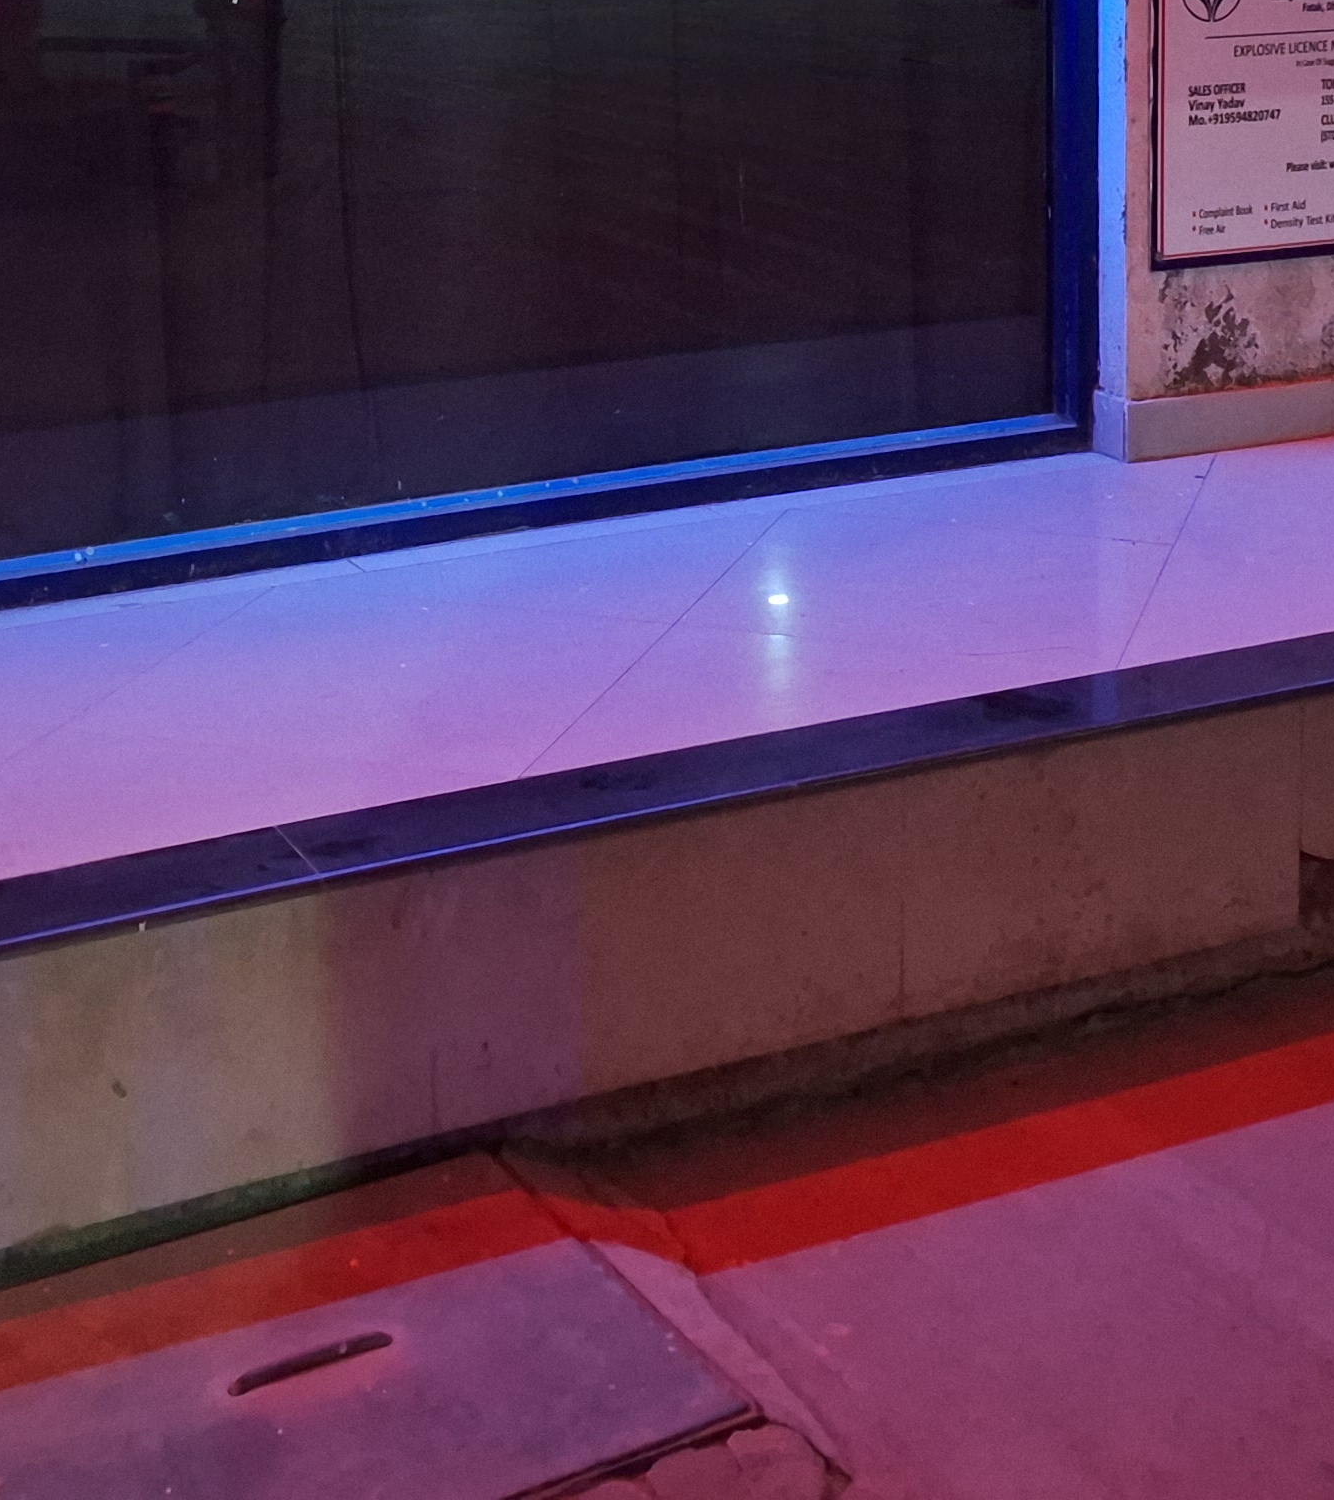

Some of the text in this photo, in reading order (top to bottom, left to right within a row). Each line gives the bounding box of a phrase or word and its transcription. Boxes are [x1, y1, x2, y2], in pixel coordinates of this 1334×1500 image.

[1233, 42, 1286, 58] EXPLOSIVE
[1288, 39, 1328, 55] LICENCE
[1188, 82, 1246, 97] SALES OFFICER
[1188, 95, 1246, 113] Vinay Yadav
[1270, 199, 1306, 213] First Aid
[1270, 217, 1304, 230] Density
[1305, 215, 1323, 226] Test
